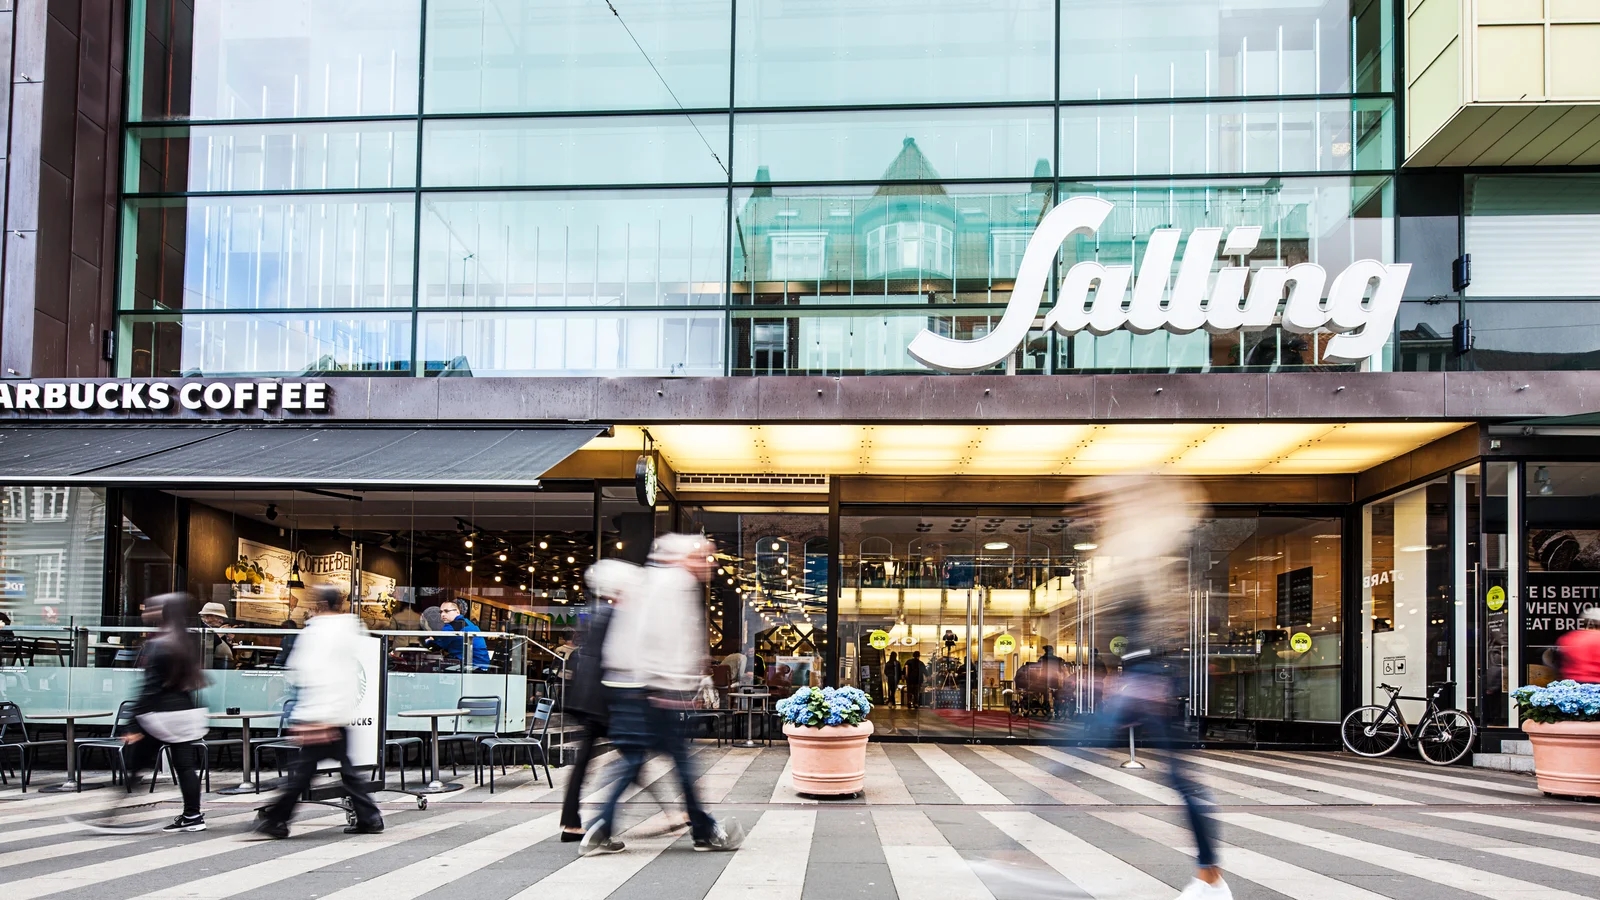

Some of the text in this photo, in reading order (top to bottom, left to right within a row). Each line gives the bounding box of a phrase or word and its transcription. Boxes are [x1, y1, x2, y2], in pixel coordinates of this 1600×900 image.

[907, 195, 1412, 371] Salling
[179, 382, 326, 410] COFFEE
[1526, 586, 1600, 598] E IS BETT
[1526, 602, 1568, 614] WHEN
[1526, 618, 1551, 630] EAT
[349, 717, 373, 726] UCKS
